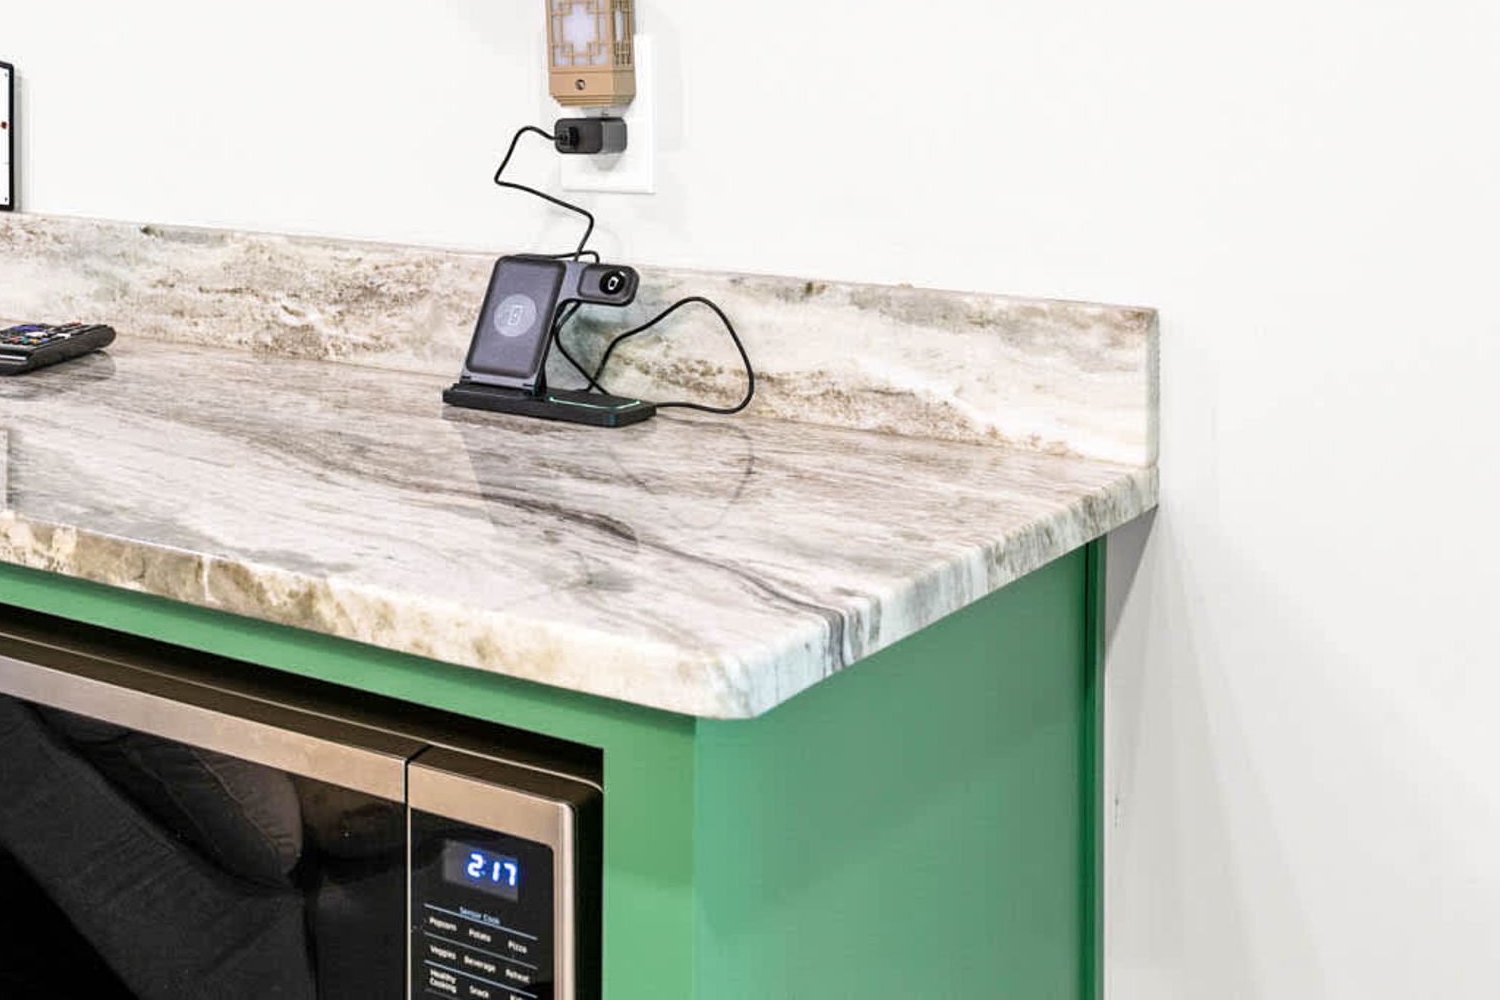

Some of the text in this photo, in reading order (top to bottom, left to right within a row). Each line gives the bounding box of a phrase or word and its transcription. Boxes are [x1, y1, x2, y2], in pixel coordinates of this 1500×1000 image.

[507, 940, 528, 955] Pizza
[463, 954, 497, 974] Beverage
[468, 984, 490, 999] Snack
